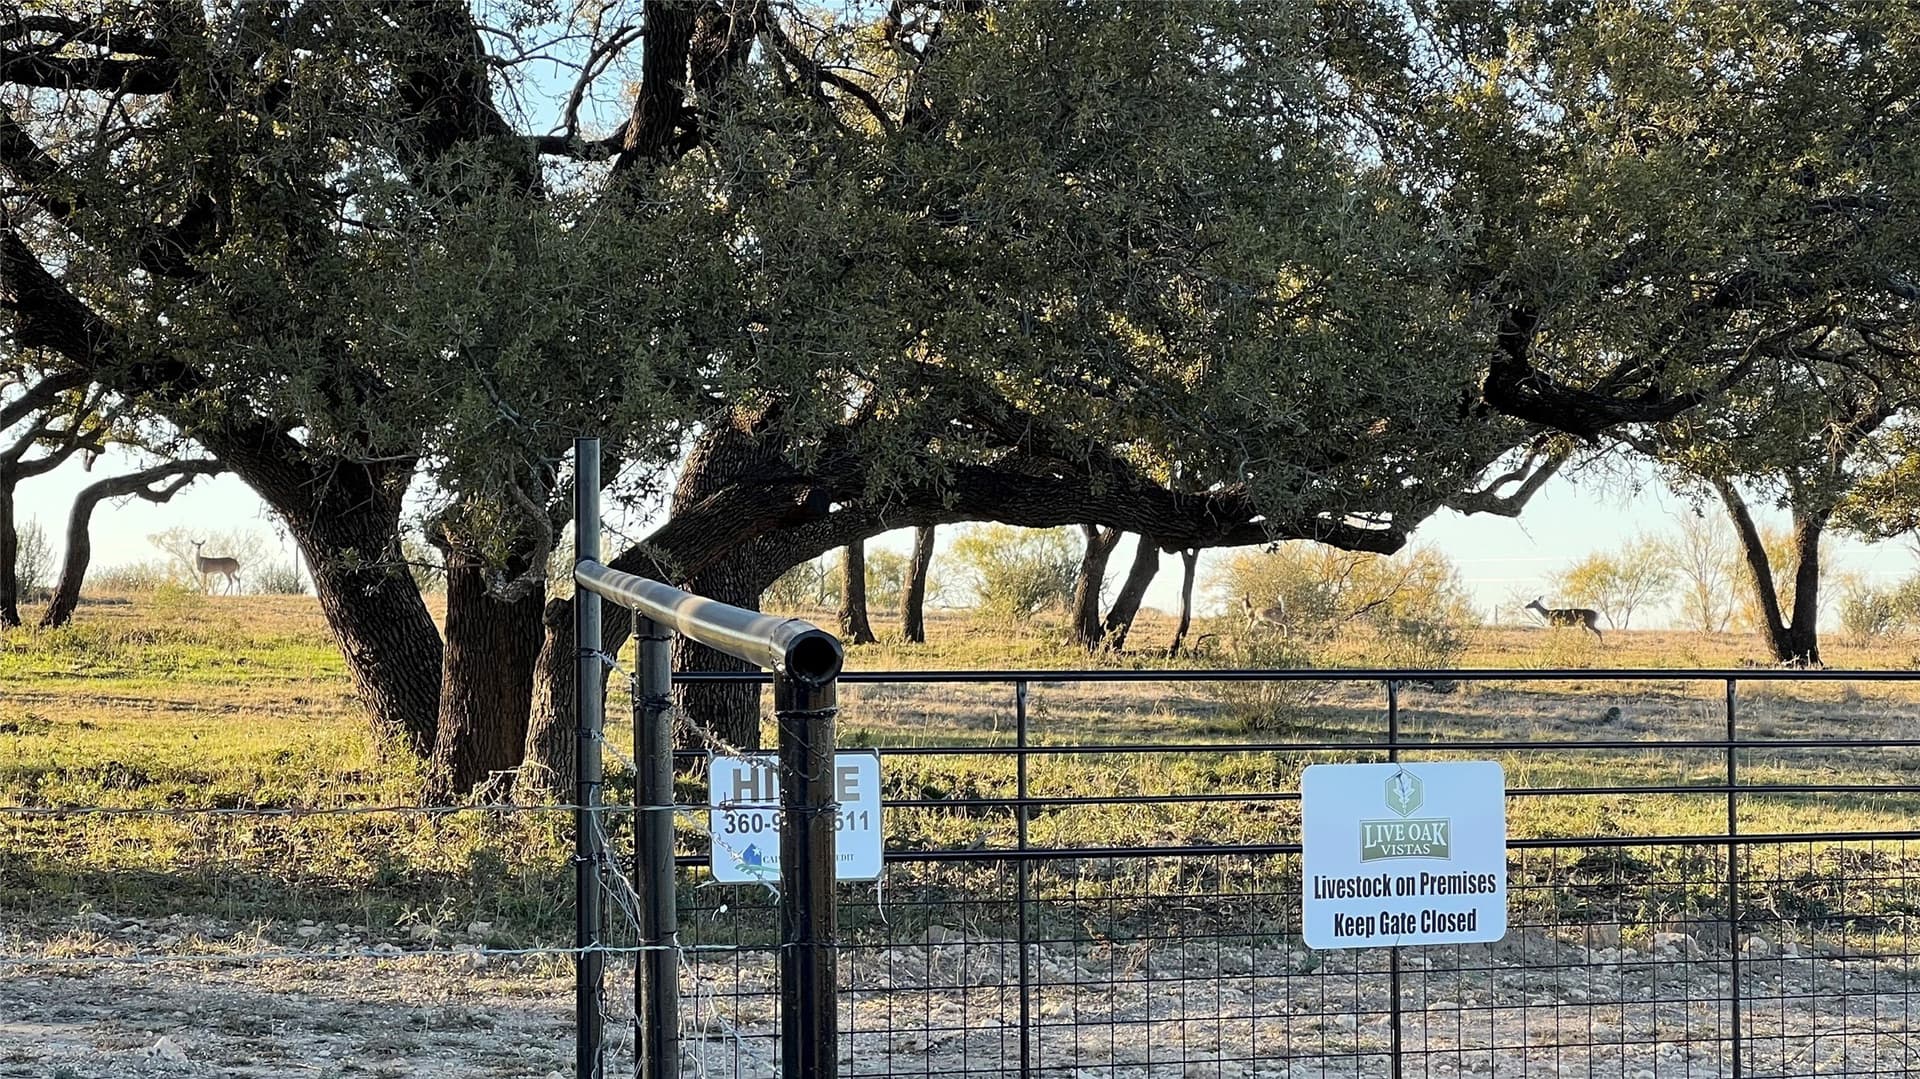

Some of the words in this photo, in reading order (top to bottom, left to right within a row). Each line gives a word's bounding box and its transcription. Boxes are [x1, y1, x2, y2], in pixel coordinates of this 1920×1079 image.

[1363, 823, 1405, 849] LIVE
[1408, 822, 1447, 847] OAK
[1381, 843, 1431, 856] VISTAS
[1314, 873, 1392, 900] Livestock
[1396, 876, 1416, 897] on
[1420, 870, 1496, 896] Premises
[1334, 912, 1375, 938] Keep
[1379, 911, 1416, 935] Gate
[1420, 908, 1477, 933] Closed
